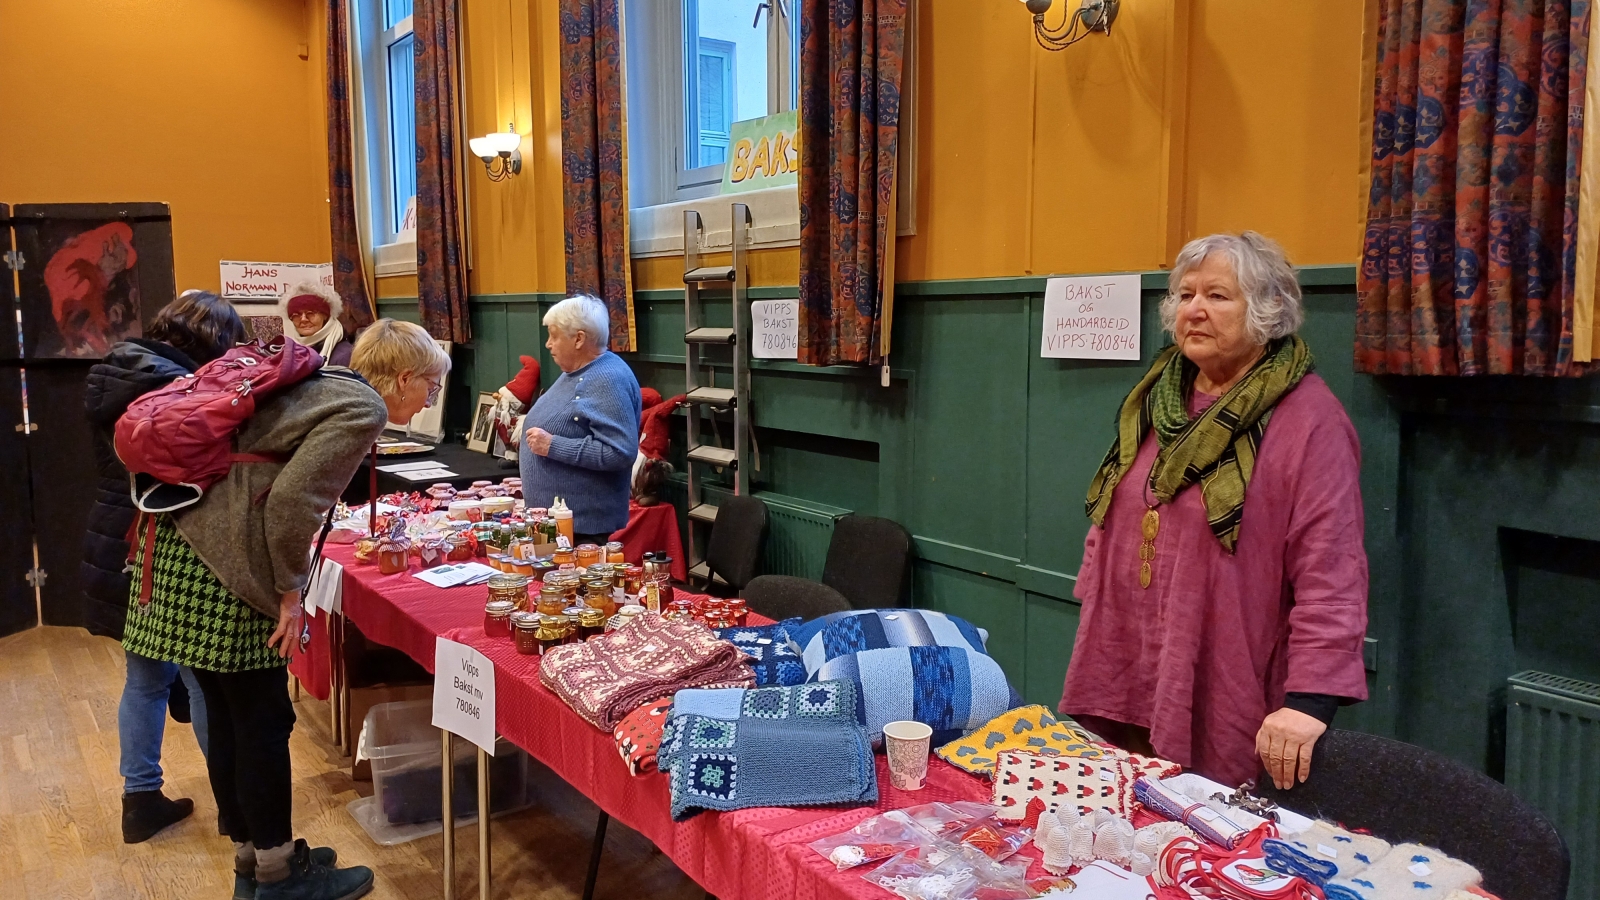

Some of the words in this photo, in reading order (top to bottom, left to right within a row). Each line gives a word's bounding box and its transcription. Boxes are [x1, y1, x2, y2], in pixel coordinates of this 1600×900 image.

[241, 266, 278, 279] HANS
[225, 280, 278, 294] NORMANN
[1065, 283, 1116, 300] BAKST
[762, 303, 791, 315] VIPPS
[1078, 302, 1094, 313] OG
[763, 318, 795, 329] BAKST
[1056, 316, 1130, 331] HANDARBEID
[762, 333, 797, 350] 780846
[461, 658, 480, 678] Vipps
[453, 676, 474, 696] Bakst
[474, 689, 484, 701] mv
[455, 697, 481, 720] 780846
